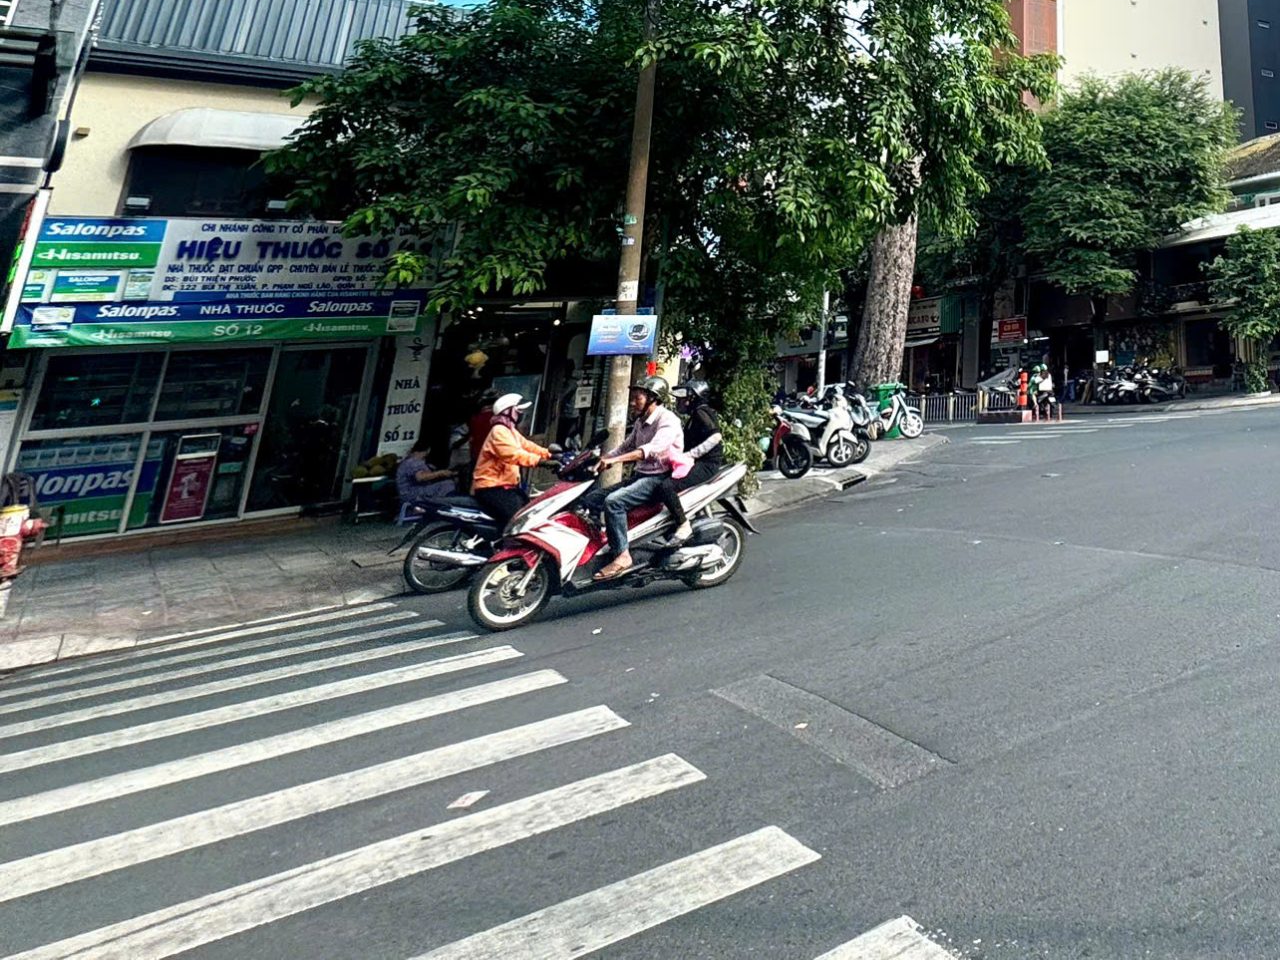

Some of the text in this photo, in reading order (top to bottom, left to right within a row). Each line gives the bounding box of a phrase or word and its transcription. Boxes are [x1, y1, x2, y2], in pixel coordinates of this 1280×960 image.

[46, 222, 147, 238] Salonpas
[201, 223, 217, 232] CHI
[219, 223, 249, 233] NHÁNH
[251, 223, 275, 233] CÔNG
[278, 224, 290, 233] TY
[37, 248, 141, 262] Hisamitsu
[176, 236, 242, 262] HIỆU
[256, 236, 343, 259] THUỐC
[355, 236, 394, 259] SỐ
[166, 262, 185, 274] NHÀ
[188, 262, 215, 274] THUỐC
[266, 264, 284, 274] GPP
[288, 262, 319, 274] CHUYÊN
[96, 305, 179, 319] Salonpas
[200, 303, 285, 315] NHÀ THUỐC
[307, 301, 373, 313] Salonpas
[212, 323, 263, 336] SỐ 12
[394, 376, 421, 390] NHÀ
[387, 399, 421, 415] THUỐC
[384, 425, 415, 442] SỐ 12
